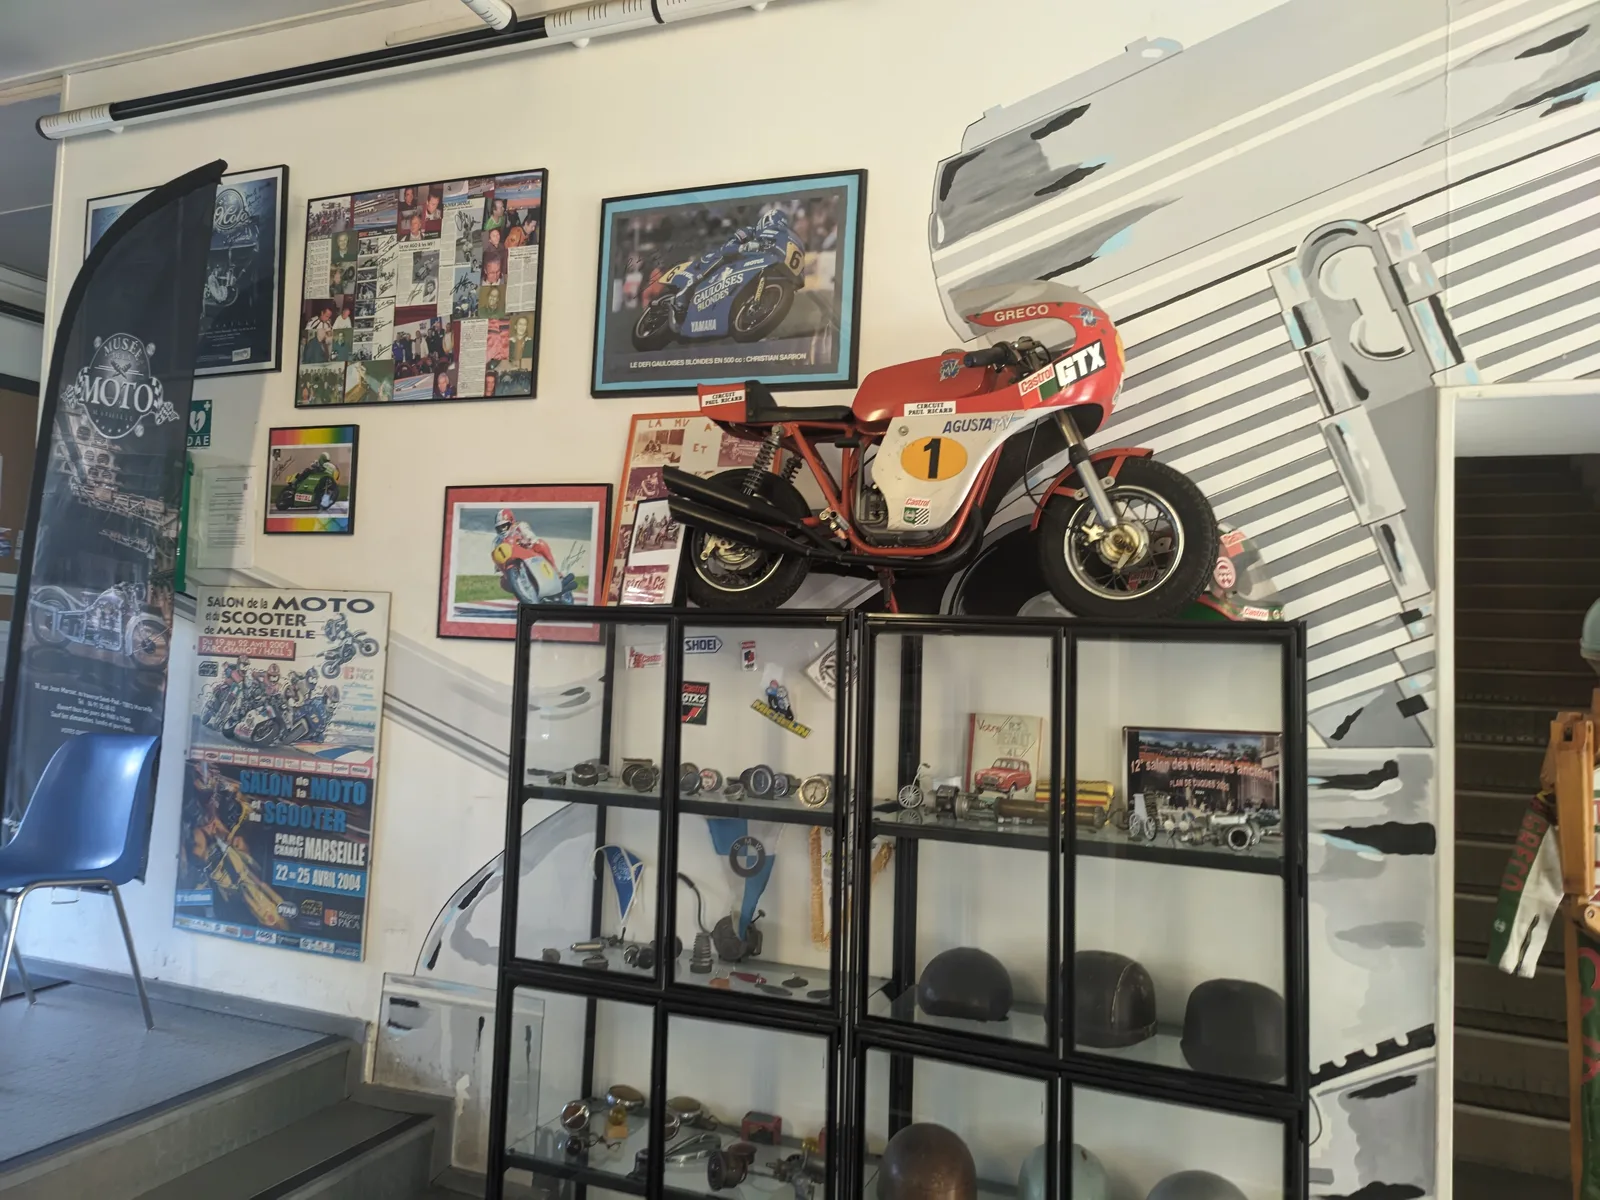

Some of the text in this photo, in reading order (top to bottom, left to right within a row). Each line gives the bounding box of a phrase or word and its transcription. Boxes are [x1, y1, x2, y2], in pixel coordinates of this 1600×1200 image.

[790, 251, 802, 269] 6
[693, 273, 744, 305] GAULOISES
[697, 288, 729, 312] BLONDES
[994, 304, 1049, 322] GRECO
[691, 319, 717, 332] YAMAHA
[104, 337, 142, 360] MUSÉE
[651, 359, 685, 367] GAULOISES
[685, 357, 714, 366] BLONDES
[746, 354, 779, 363] CHRISTIAN
[779, 352, 807, 361] SARRON
[1055, 341, 1106, 387] GTX
[1020, 365, 1053, 395] Castrol
[79, 374, 153, 413] MOTO
[712, 391, 735, 400] CIRCUIT
[720, 395, 742, 404] RICARD
[648, 419, 662, 428] LA
[942, 417, 992, 434] AGUSTA
[186, 434, 210, 446] DAE
[693, 443, 708, 454] ET
[923, 438, 941, 479] 1
[207, 596, 375, 613] SALON de la MOTO
[221, 611, 307, 627] SCOOTER
[204, 626, 316, 639] de MARSEILLE
[215, 638, 225, 646] 19
[685, 639, 717, 651] SHOEI
[223, 646, 257, 655] CHANOT
[264, 648, 285, 656] HALL
[683, 684, 708, 693] Castrol
[1145, 758, 1170, 773] salon
[1171, 757, 1188, 771] des
[1190, 757, 1235, 774] véhicules
[240, 770, 366, 805] SALON de la MOTO
[263, 800, 347, 833] SCOOTER
[274, 844, 304, 858] CHANOT
[275, 833, 367, 866] PARC MARSEILLE
[275, 864, 289, 881] 22
[297, 867, 310, 884] 25
[312, 869, 336, 888] AVRIL
[337, 873, 361, 891] 2004
